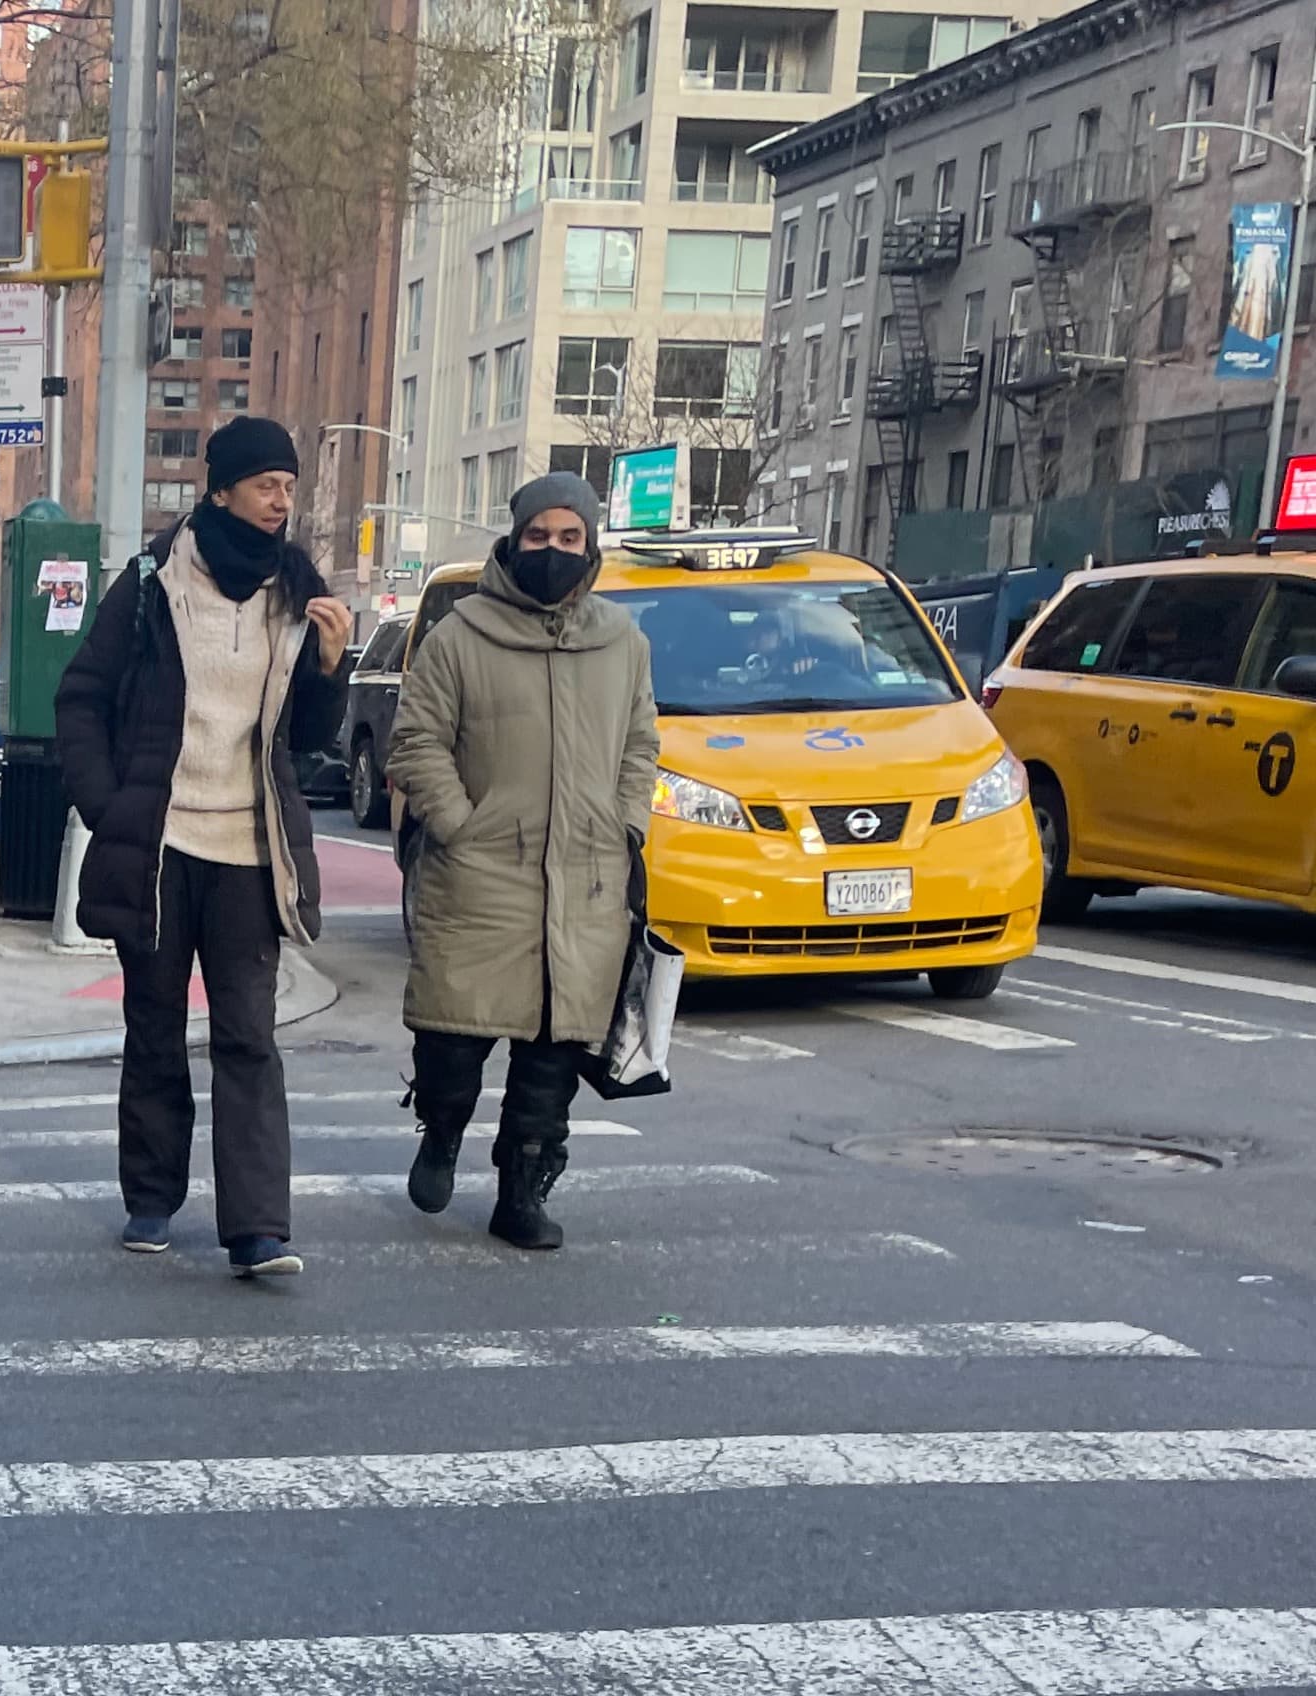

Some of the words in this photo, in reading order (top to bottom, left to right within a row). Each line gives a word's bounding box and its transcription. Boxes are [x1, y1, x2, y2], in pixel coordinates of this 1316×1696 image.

[1235, 227, 1286, 237] FINANCIAL
[707, 548, 760, 569] 3E97
[1269, 744, 1290, 788] T
